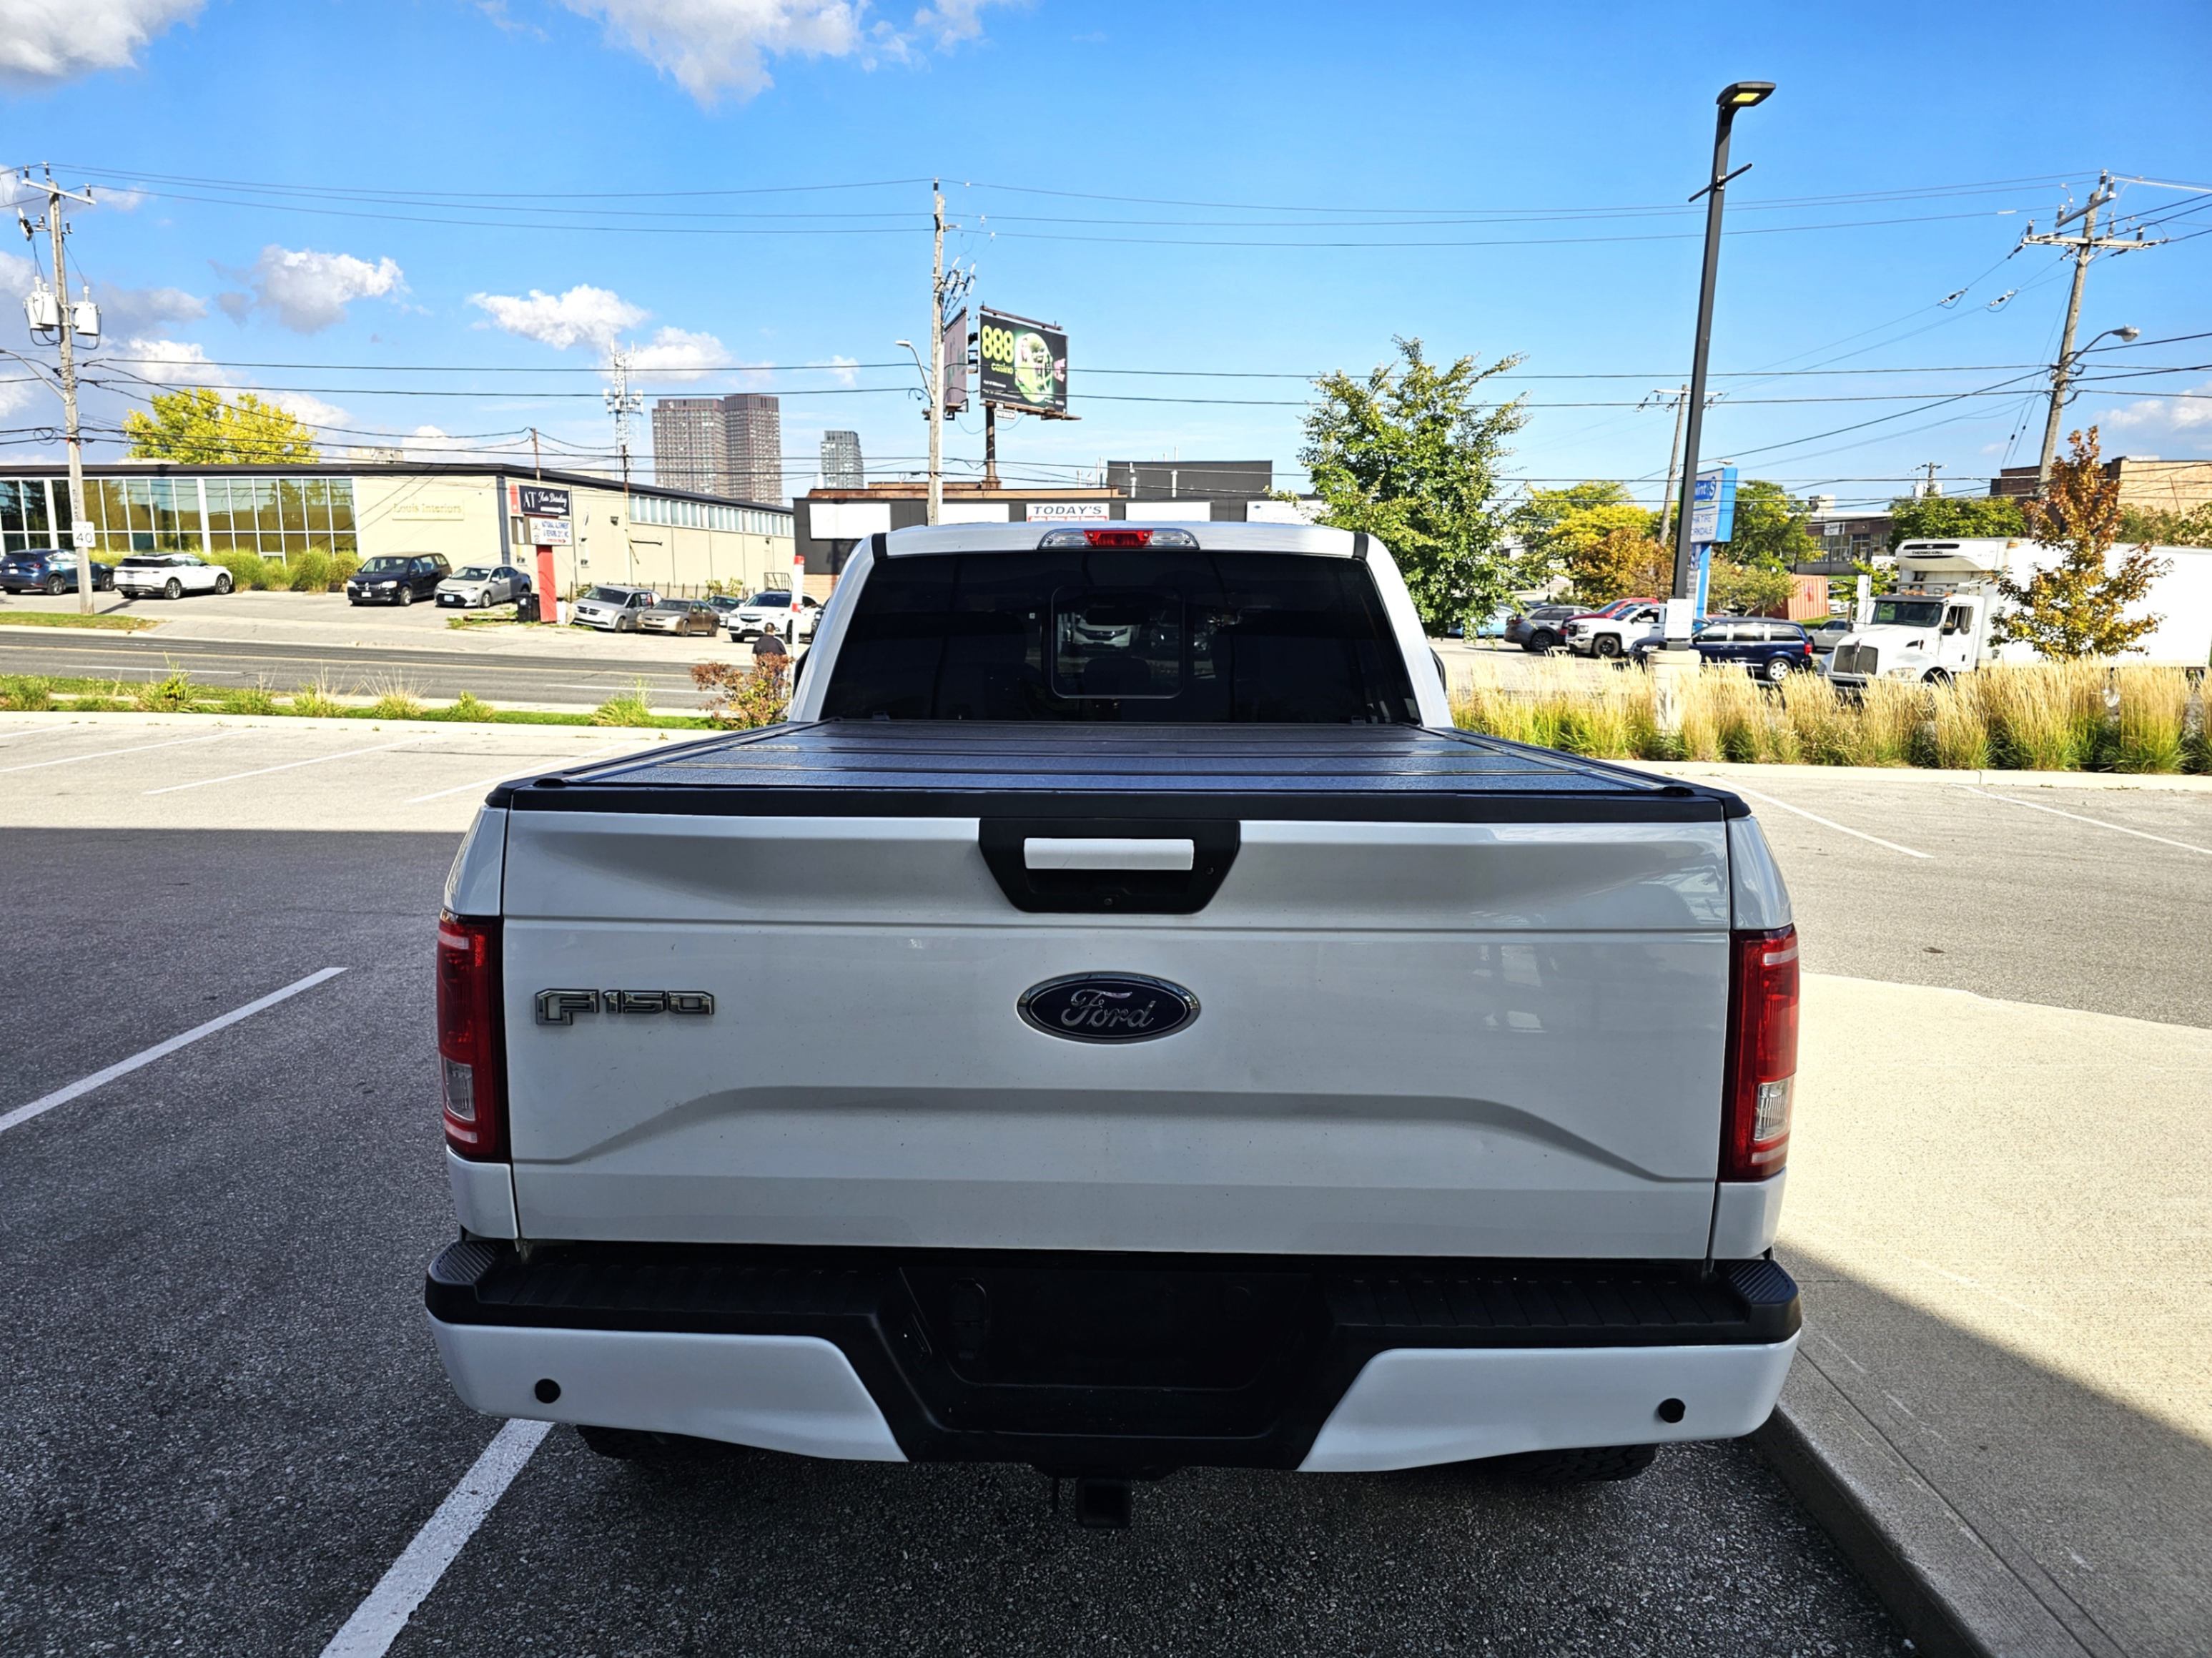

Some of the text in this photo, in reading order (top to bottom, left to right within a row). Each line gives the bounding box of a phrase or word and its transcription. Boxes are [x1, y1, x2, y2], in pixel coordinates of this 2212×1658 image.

[982, 325, 1014, 363] 888
[991, 362, 1014, 375] casino
[1033, 505, 1102, 515] TODAY'S
[76, 532, 93, 543] 40
[1060, 988, 1156, 1028] Ford
